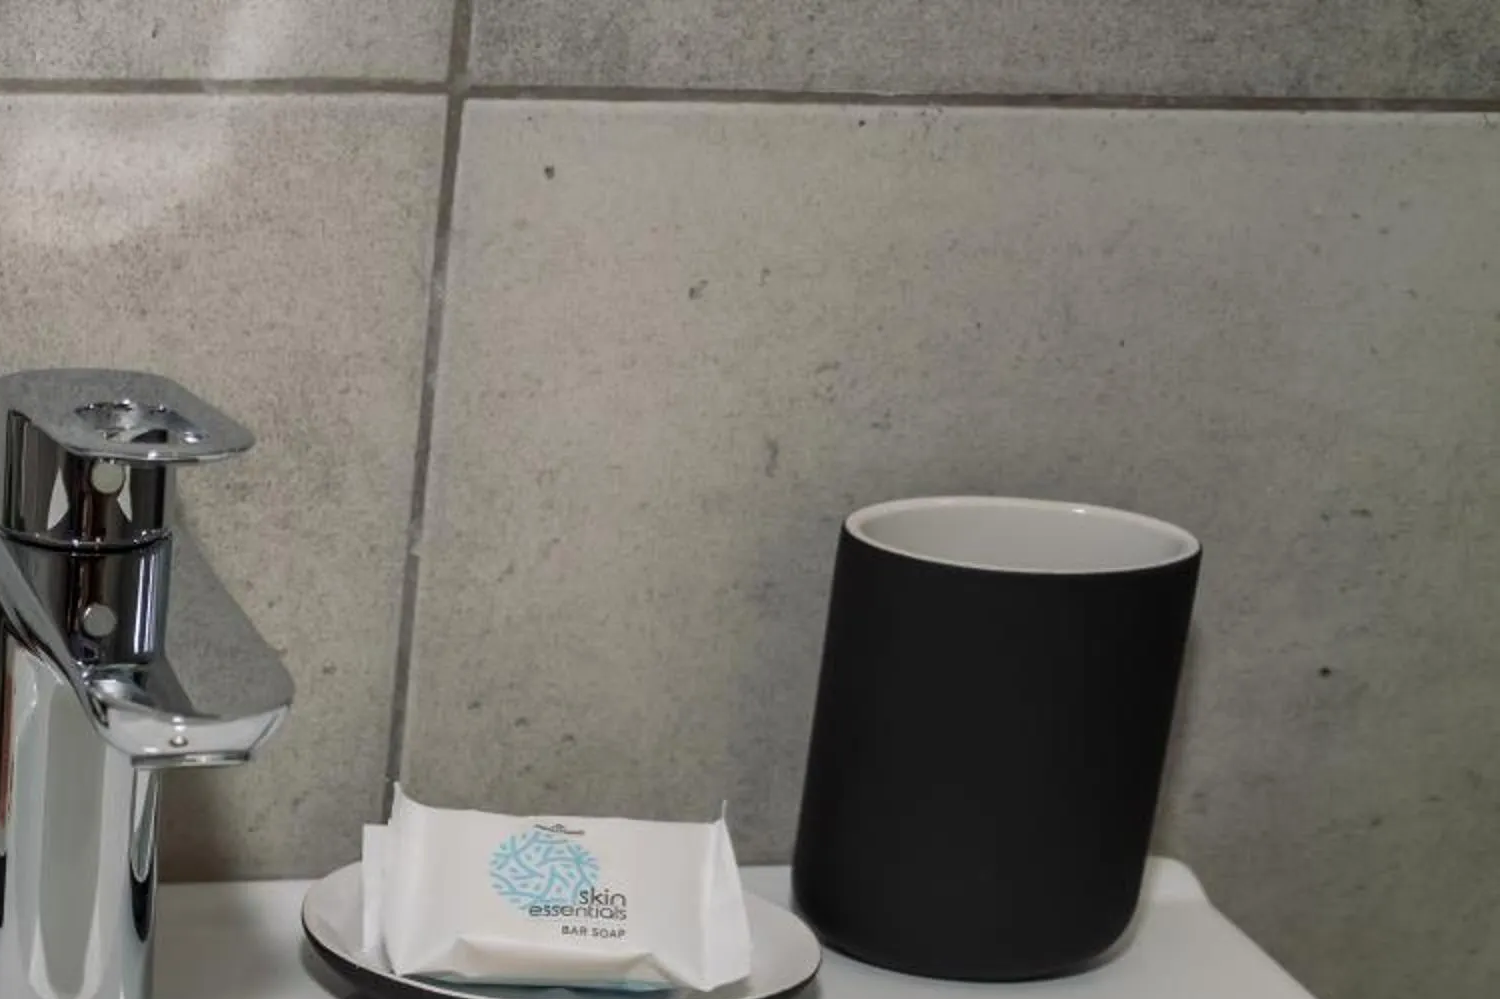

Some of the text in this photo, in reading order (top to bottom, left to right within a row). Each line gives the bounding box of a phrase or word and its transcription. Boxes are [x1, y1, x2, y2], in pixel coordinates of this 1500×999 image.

[579, 886, 627, 906] skin
[529, 905, 627, 921] essentials
[561, 925, 626, 939] BAR SOAP
